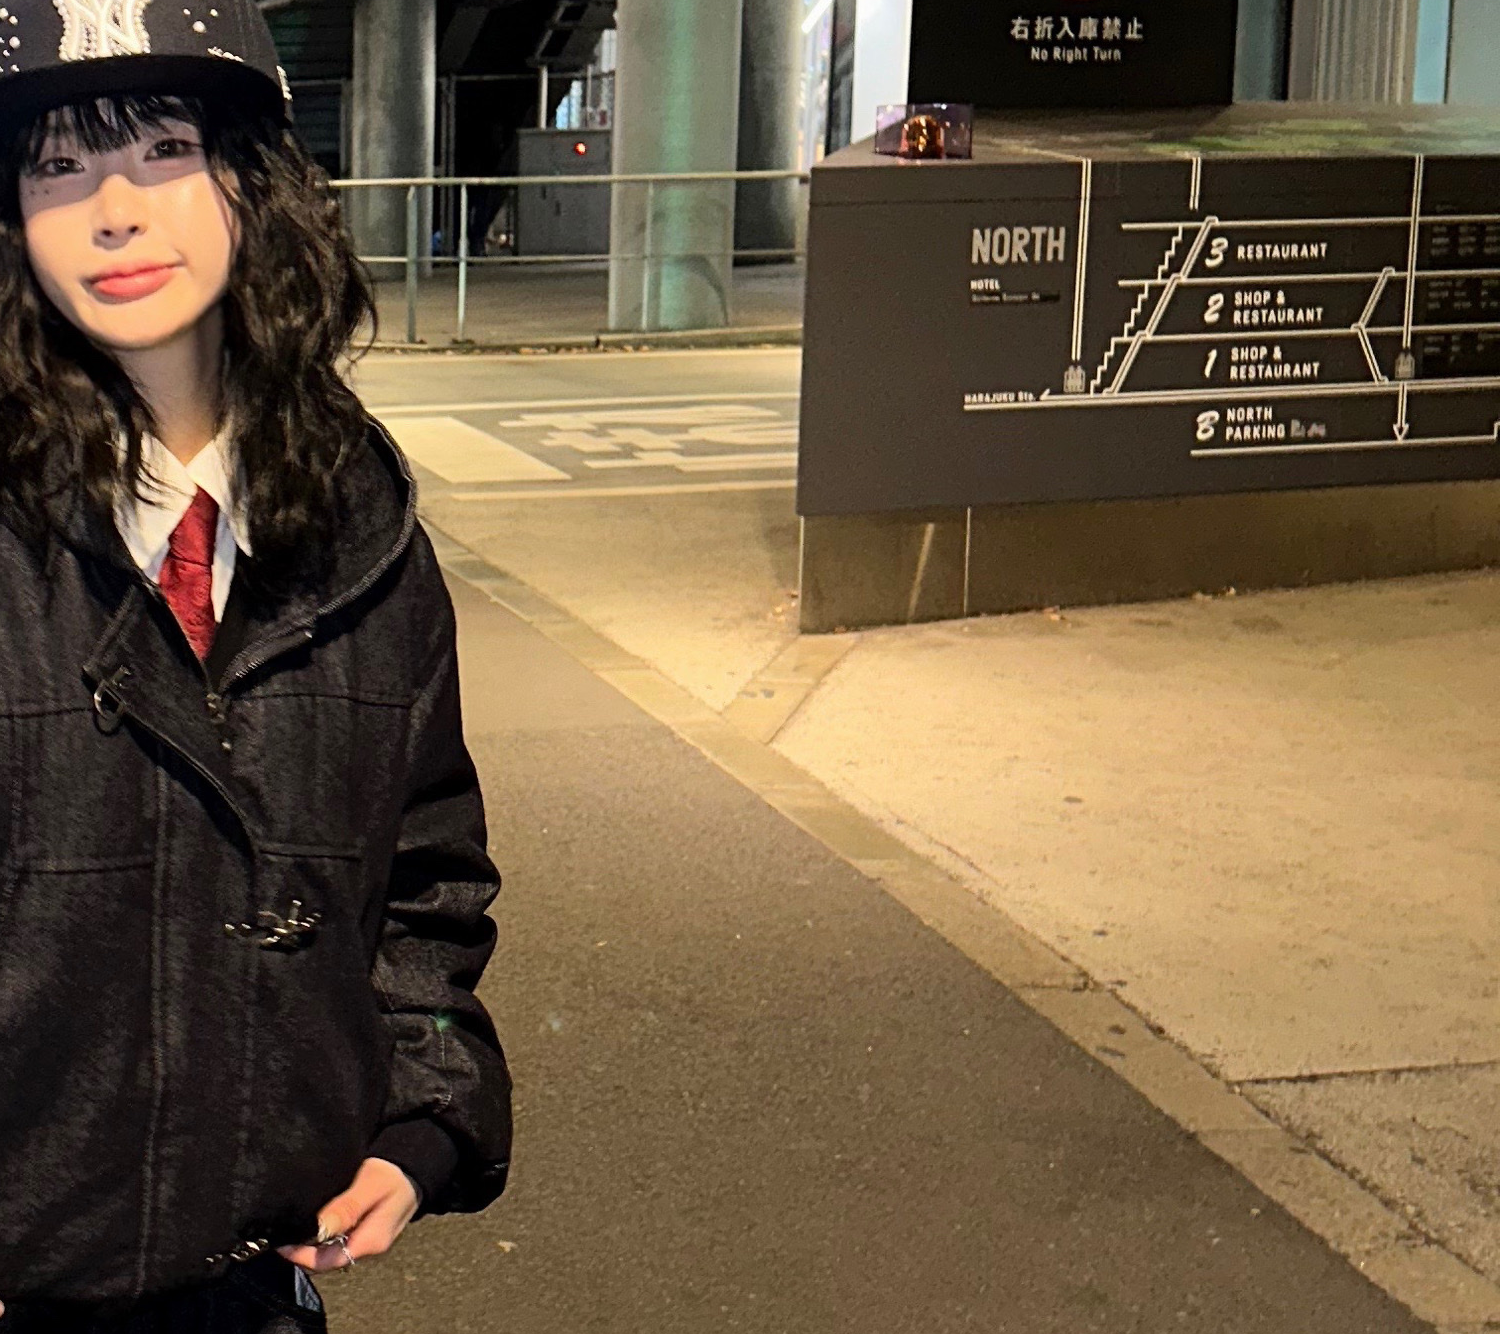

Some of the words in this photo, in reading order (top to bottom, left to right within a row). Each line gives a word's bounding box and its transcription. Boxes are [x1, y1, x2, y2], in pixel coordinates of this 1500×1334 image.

[1009, 15, 1144, 40] 右折入庫禁止
[1031, 46, 1049, 62] No
[1053, 46, 1088, 64] Right
[1092, 46, 1122, 62] Turn
[971, 226, 1066, 266] NORTH
[1204, 236, 1229, 268] 3
[1237, 242, 1328, 261] RESTAURANT
[1234, 290, 1271, 307] SHOP
[1276, 289, 1286, 306] &
[1203, 292, 1225, 324] 2
[1233, 307, 1323, 326] RESTAURANT
[1230, 345, 1268, 363] SHOP
[1273, 344, 1283, 361] &
[1204, 348, 1218, 379] 1
[1229, 361, 1320, 381] RESTAURANT
[1226, 406, 1274, 423] NORTH
[1225, 423, 1287, 442] PARKING
